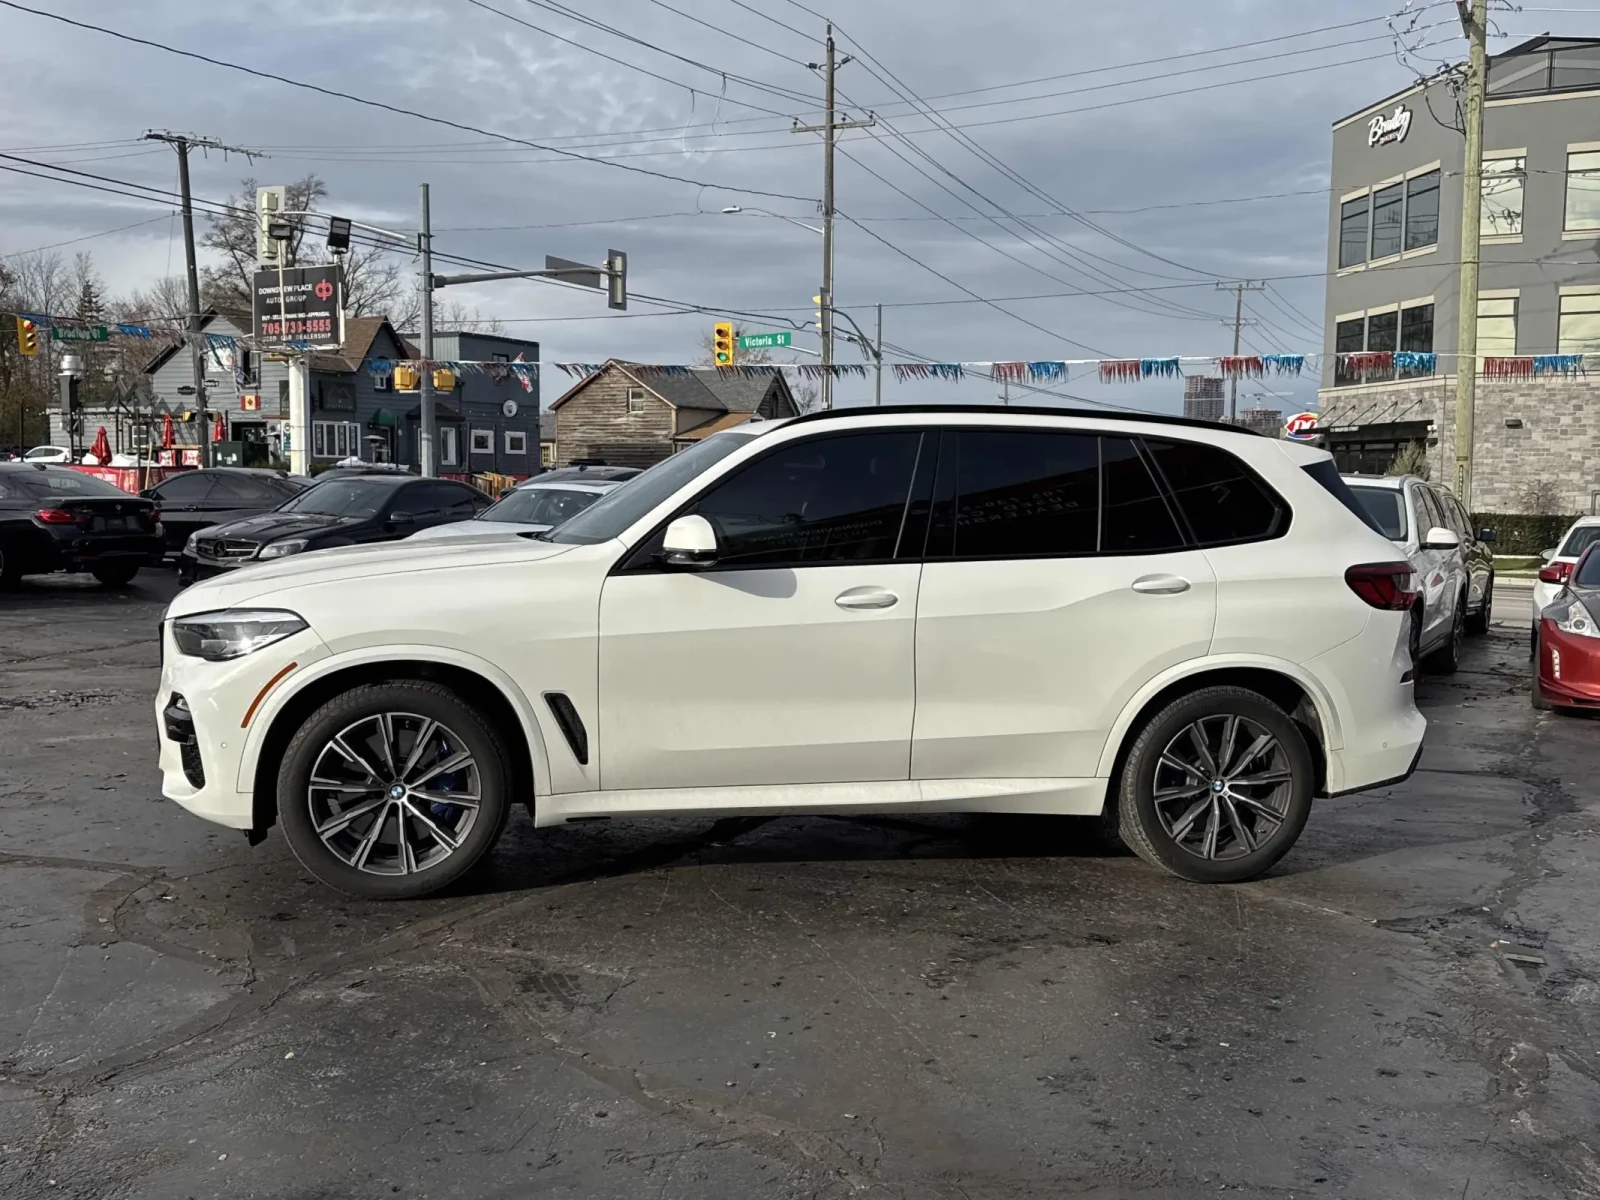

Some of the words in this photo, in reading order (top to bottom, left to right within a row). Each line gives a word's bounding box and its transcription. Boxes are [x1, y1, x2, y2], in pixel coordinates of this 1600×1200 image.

[294, 284, 313, 292] PLACE
[285, 295, 307, 303] GROUP
[745, 336, 772, 347] Victoria
[777, 335, 785, 344] St
